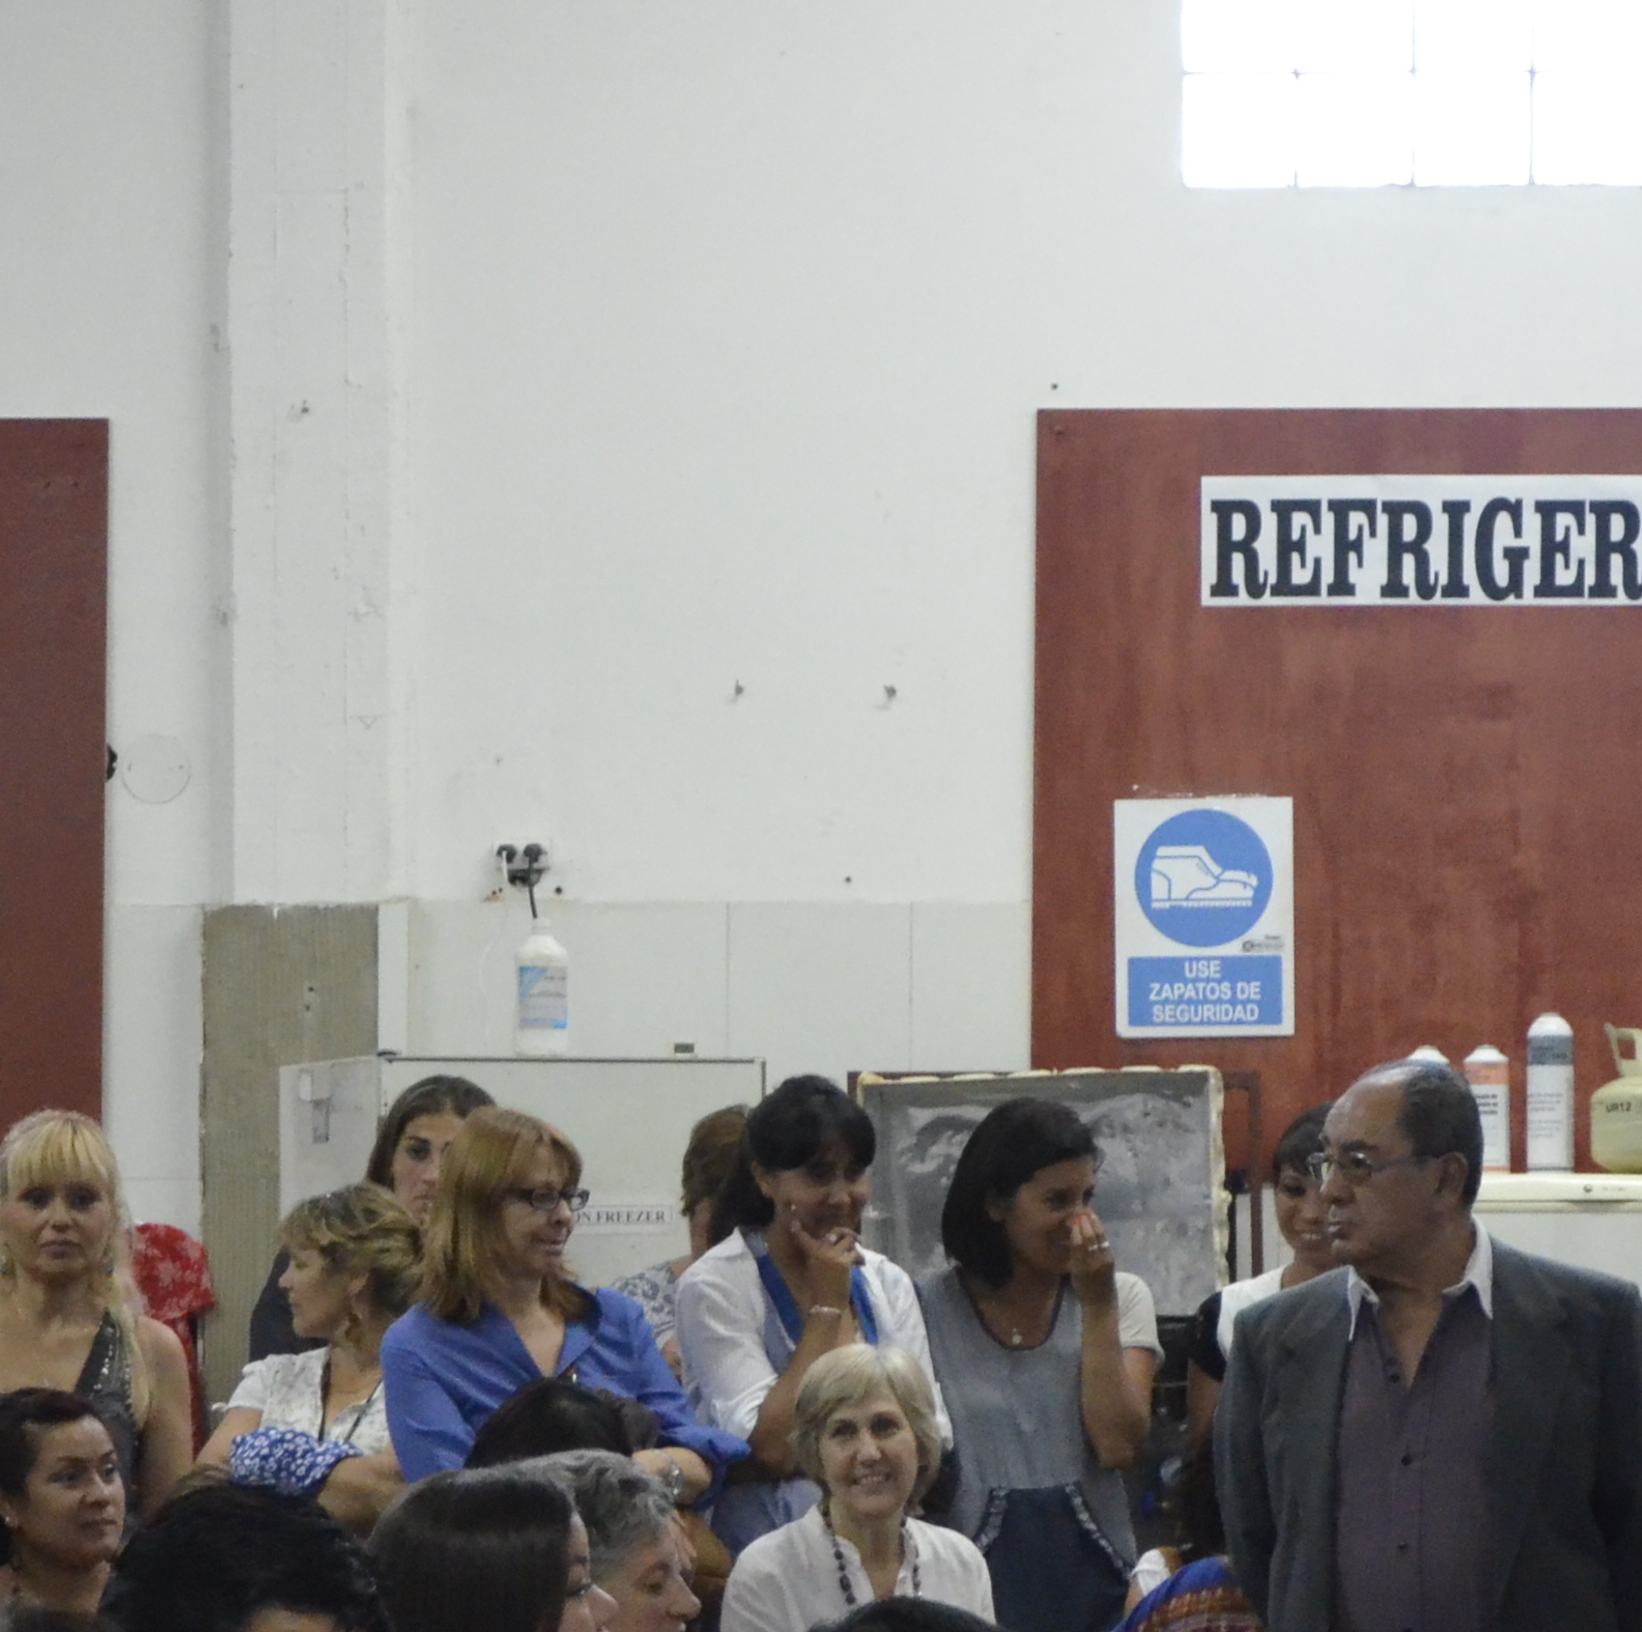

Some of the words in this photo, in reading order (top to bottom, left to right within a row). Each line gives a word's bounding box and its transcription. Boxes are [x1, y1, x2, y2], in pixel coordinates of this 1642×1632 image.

[1184, 960, 1221, 978] USE
[1148, 982, 1231, 1000] ZAPATOS
[1236, 981, 1261, 999] DE
[1152, 1003, 1259, 1022] SEGURIDAD
[597, 1211, 665, 1222] FREEZER
